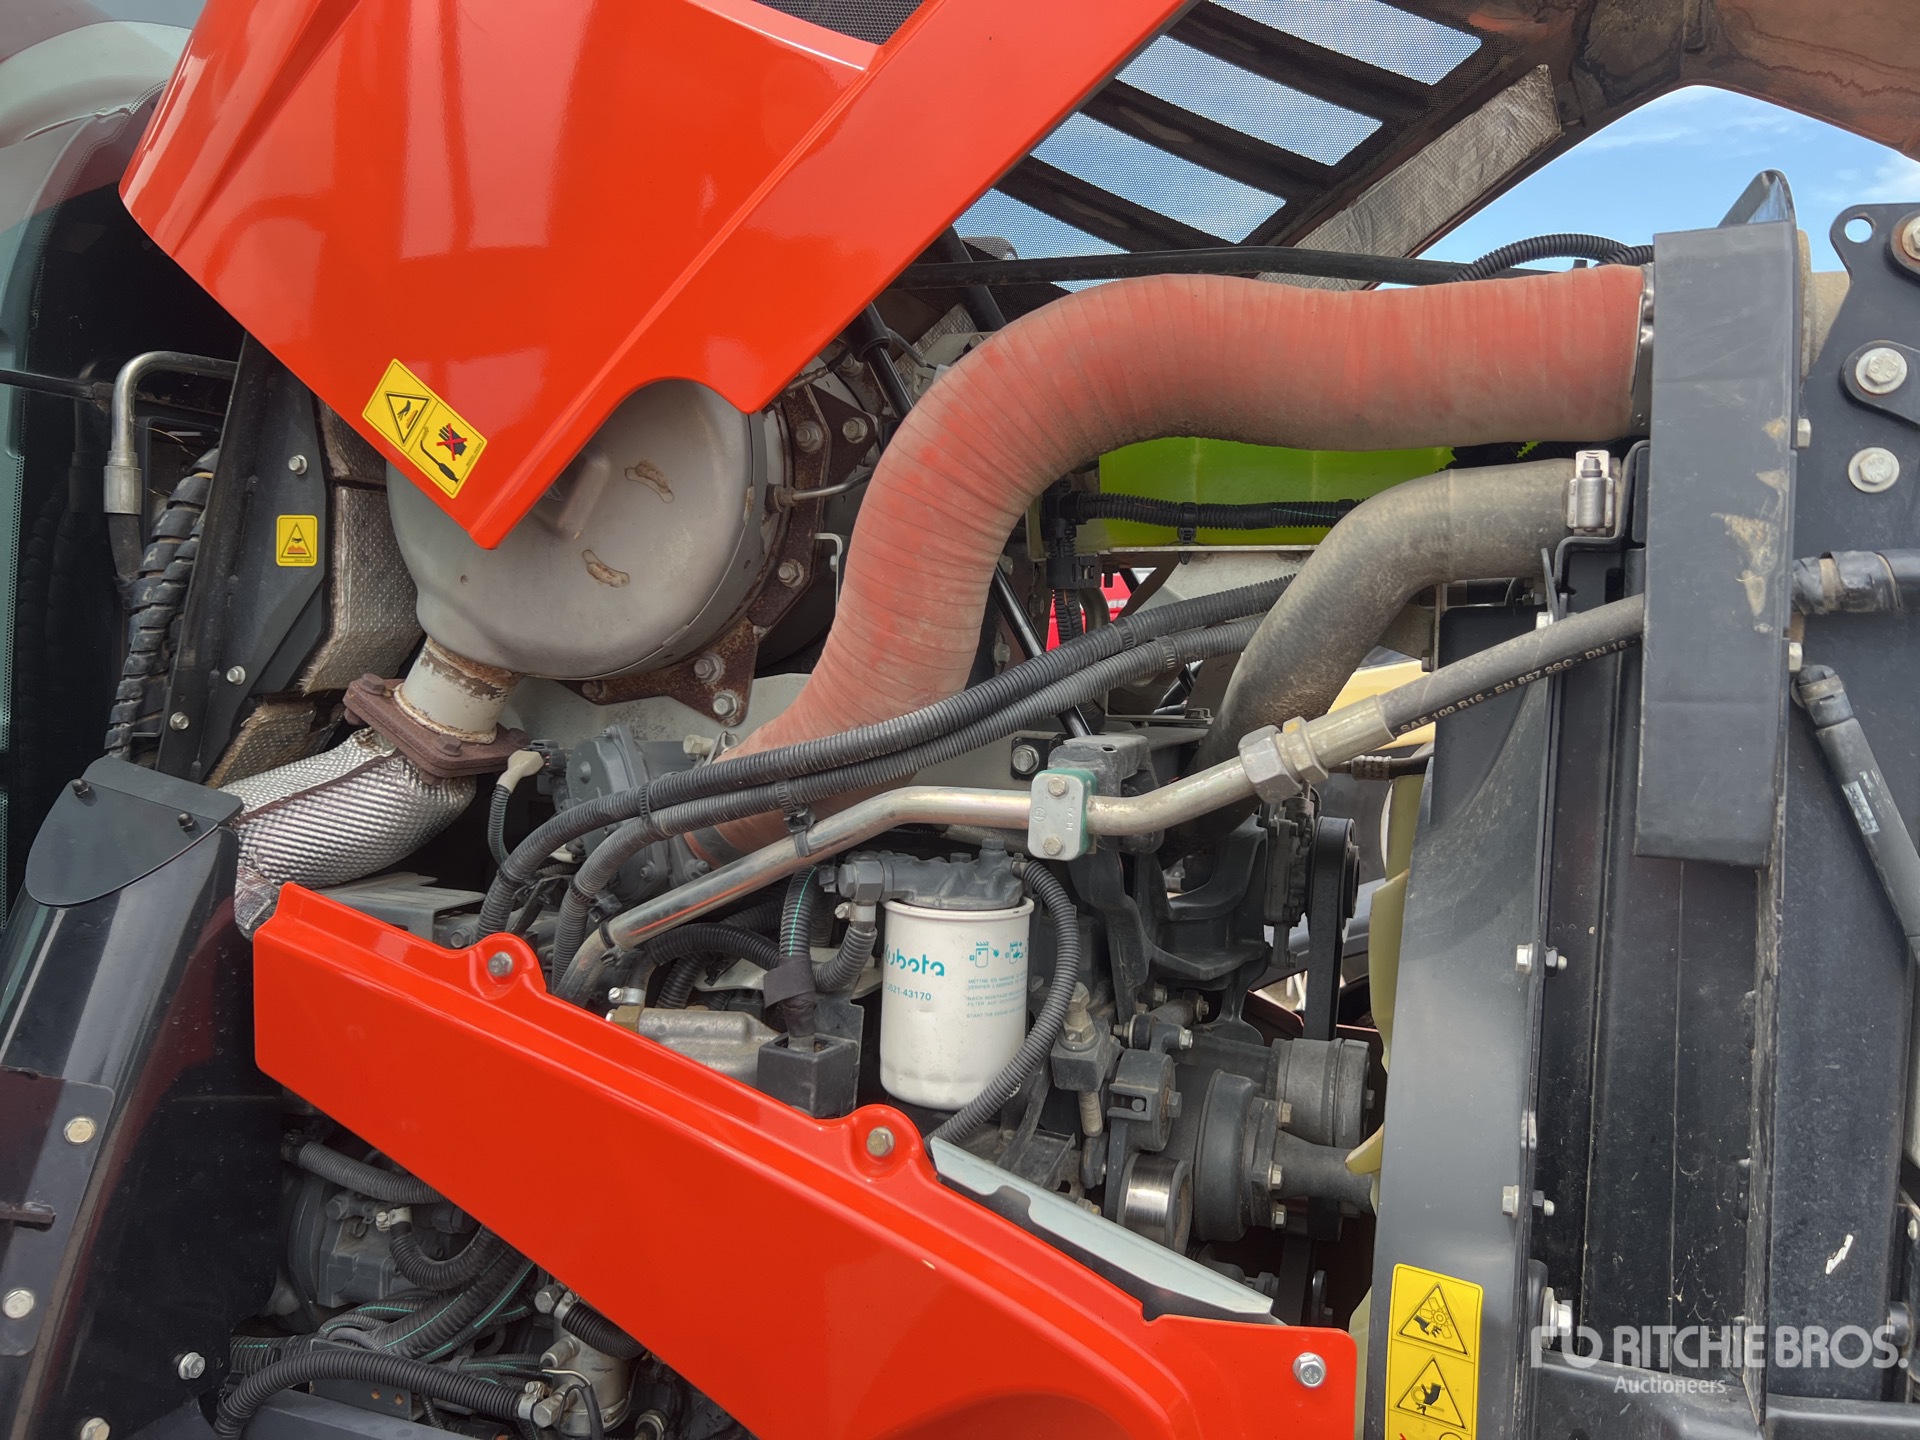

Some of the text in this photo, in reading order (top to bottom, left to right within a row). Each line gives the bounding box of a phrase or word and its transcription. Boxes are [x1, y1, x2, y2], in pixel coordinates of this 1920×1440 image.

[1400, 716, 1428, 733] SAE
[1432, 705, 1455, 719] 100
[1457, 693, 1485, 709] R16
[1494, 680, 1516, 694] EN
[1517, 670, 1541, 685] 857
[1545, 658, 1573, 675] 2SC
[1584, 646, 1607, 659] DN
[1611, 640, 1628, 651] 16
